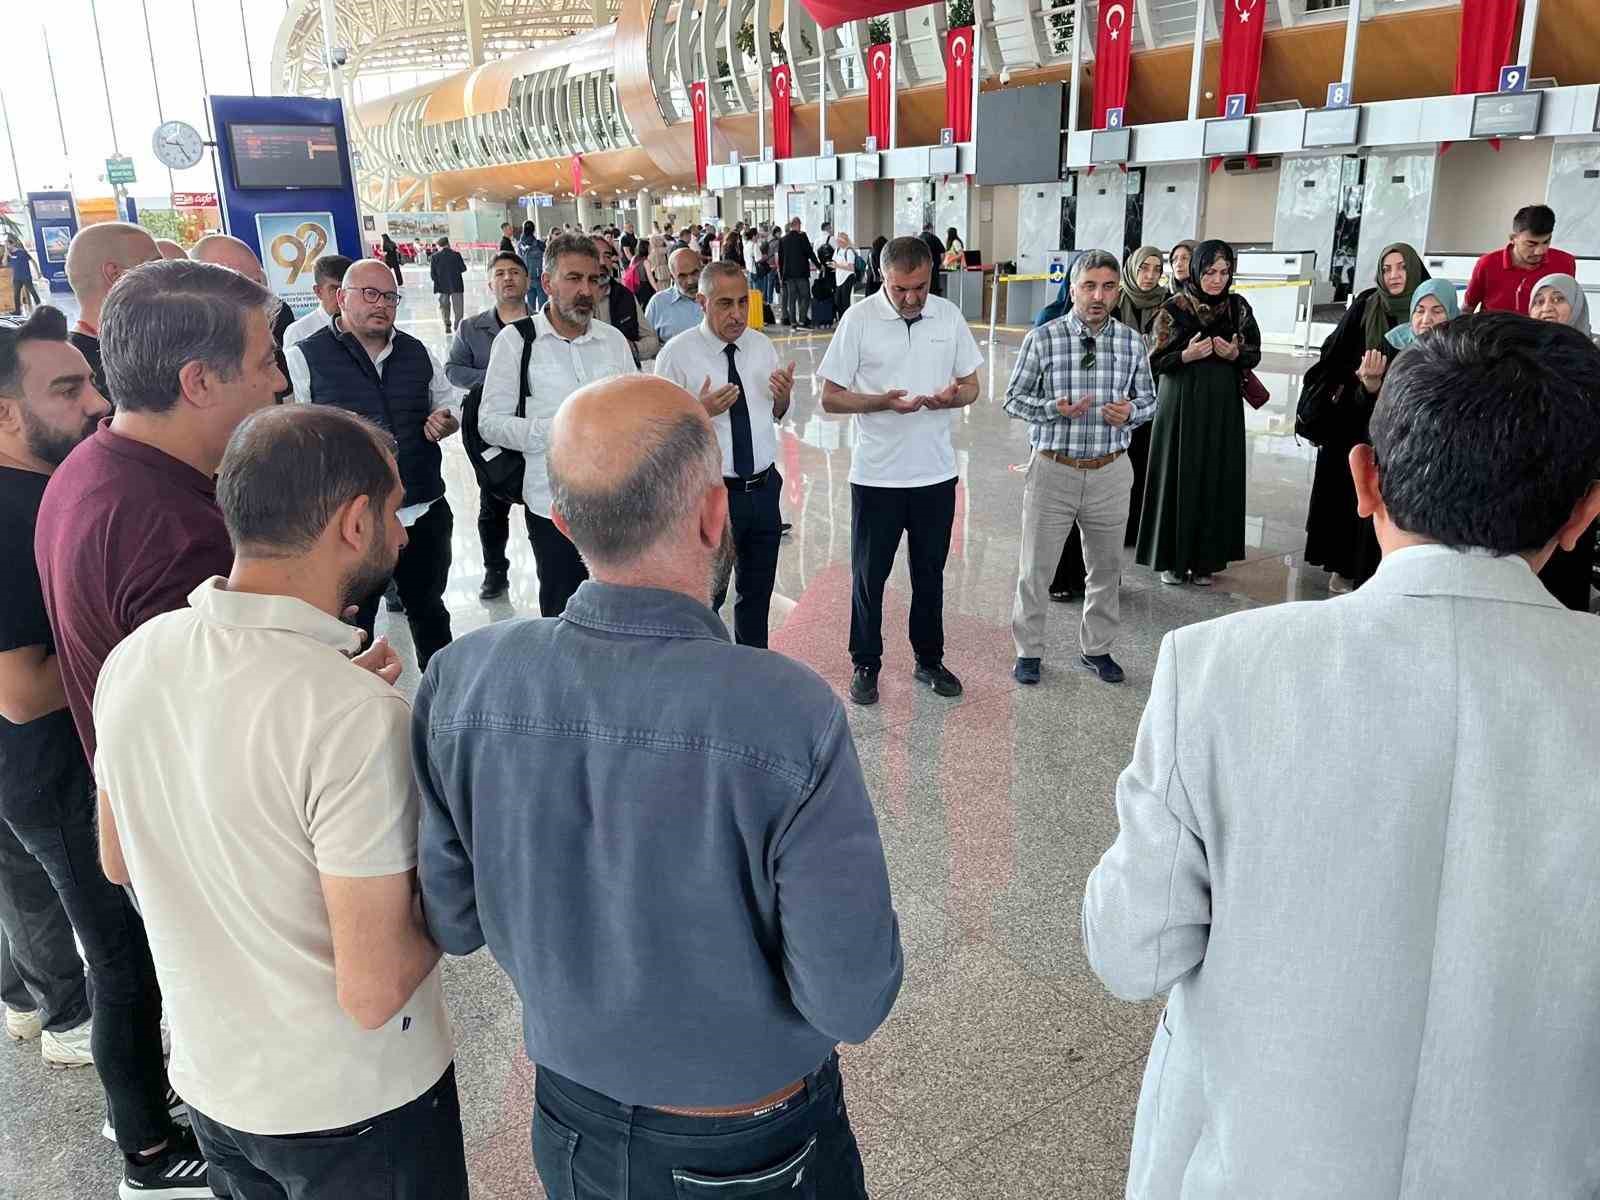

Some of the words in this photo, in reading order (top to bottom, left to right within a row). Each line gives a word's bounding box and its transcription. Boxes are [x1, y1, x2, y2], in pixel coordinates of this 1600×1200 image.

[1507, 71, 1520, 89] 9
[1334, 87, 1344, 104] 8
[1230, 99, 1241, 115] 7
[1110, 112, 1118, 126] 6
[943, 131, 950, 143] 5
[271, 223, 328, 285] 92
